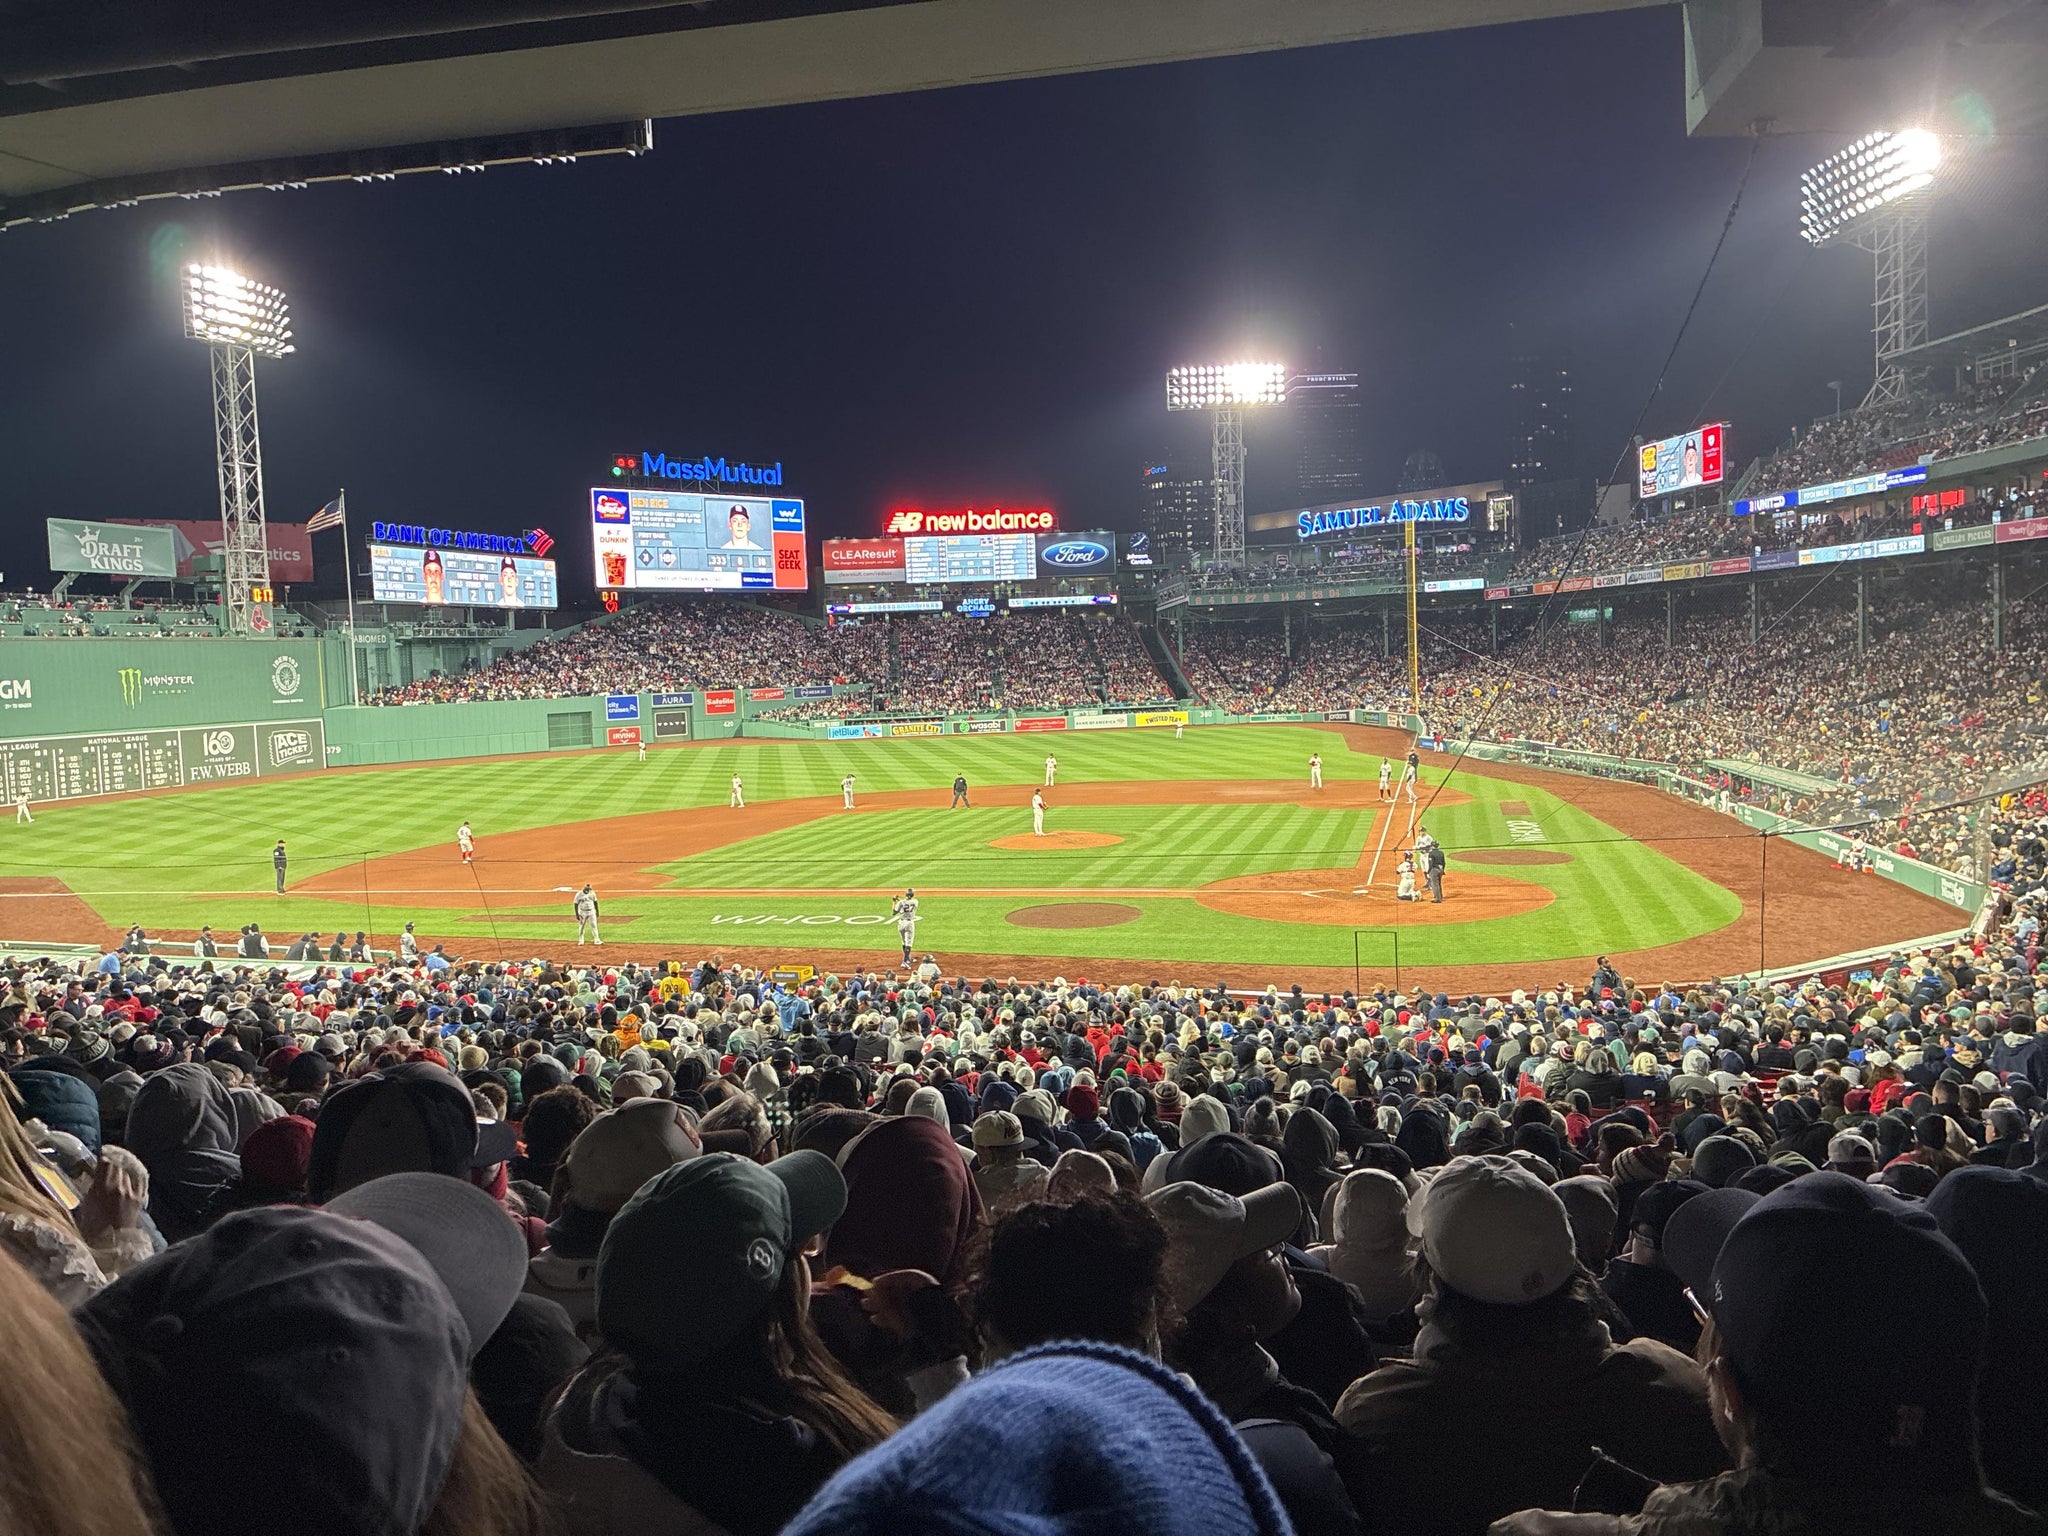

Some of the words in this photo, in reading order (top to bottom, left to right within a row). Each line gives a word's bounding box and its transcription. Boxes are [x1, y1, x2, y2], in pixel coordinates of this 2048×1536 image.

[643, 452, 782, 486] MassMutual
[650, 499, 669, 508] RICE
[926, 514, 966, 532] new
[968, 509, 1053, 531] balance
[1297, 506, 1385, 538] SAMUEL
[1387, 497, 1470, 523] ADAMS
[374, 522, 426, 544] BANK
[430, 528, 451, 546] OF
[455, 531, 525, 554] AMERICA
[81, 541, 144, 558] DRAFT
[778, 549, 800, 560] SEAT
[832, 549, 896, 560] CLEAResult
[1055, 545, 1095, 563] Ford
[90, 556, 144, 572] KINGS
[778, 560, 802, 571] GEEK
[470, 590, 477, 602] 2
[962, 598, 990, 606] ANGRY
[956, 604, 996, 612] ORCHARD
[970, 721, 1001, 730] wasabi
[1145, 715, 1169, 725] TWISTED
[832, 727, 860, 737] jetBlue
[892, 723, 925, 735] GRANITE
[925, 723, 943, 734] CITY
[88, 737, 121, 745] NATIONAL
[278, 732, 308, 749] ACE
[613, 732, 636, 740] IRVING
[11, 743, 40, 751] LEAGUE
[203, 730, 235, 757] 160
[279, 744, 308, 759] TICKET
[214, 762, 251, 778] WEBB
[903, 904, 915, 912] 27
